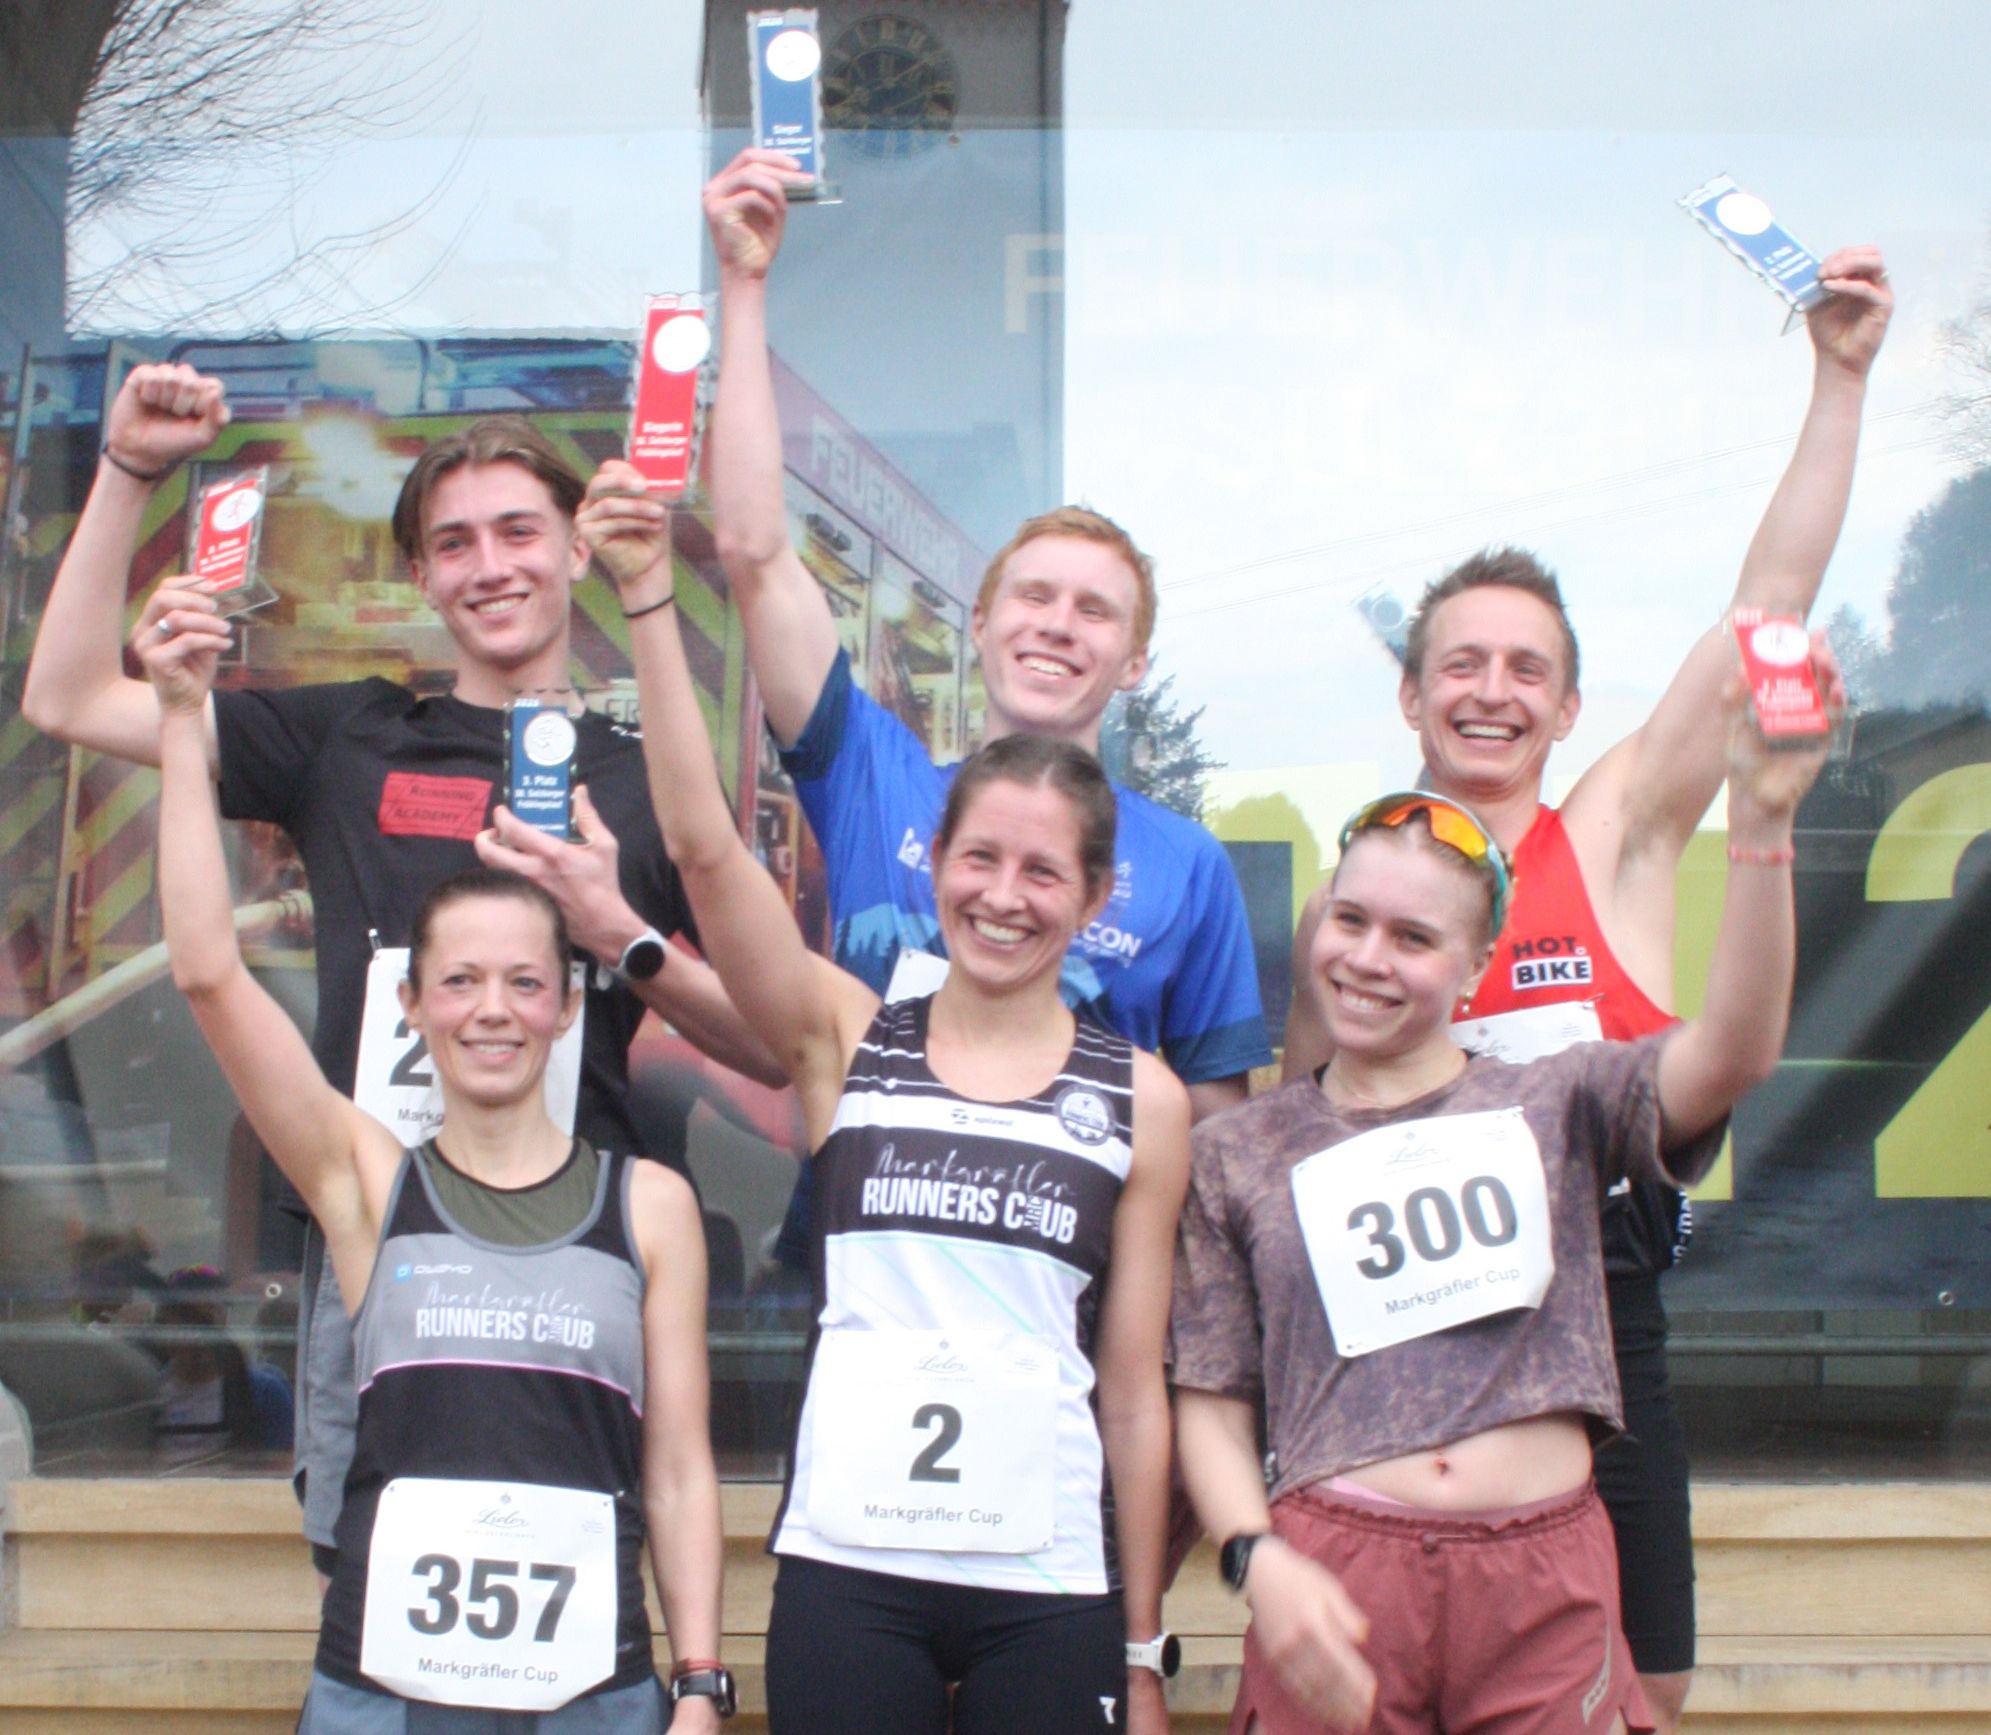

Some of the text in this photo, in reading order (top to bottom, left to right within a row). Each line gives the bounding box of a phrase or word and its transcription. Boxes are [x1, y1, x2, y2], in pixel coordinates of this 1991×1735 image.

[1080, 921, 1142, 958] CON
[1512, 936, 1576, 960] HOT
[1516, 960, 1590, 985] BIKE
[861, 1177, 1000, 1226] RUNNERS
[1347, 1175, 1518, 1281] 300
[1385, 1266, 1521, 1315] Markgräfler Cup
[415, 1307, 528, 1341] RUNNERS
[908, 1403, 963, 1484] 2
[864, 1504, 1004, 1526] Markgräfler Cup
[407, 1553, 577, 1643] 357
[417, 1657, 559, 1684] Markgräfler Cup
